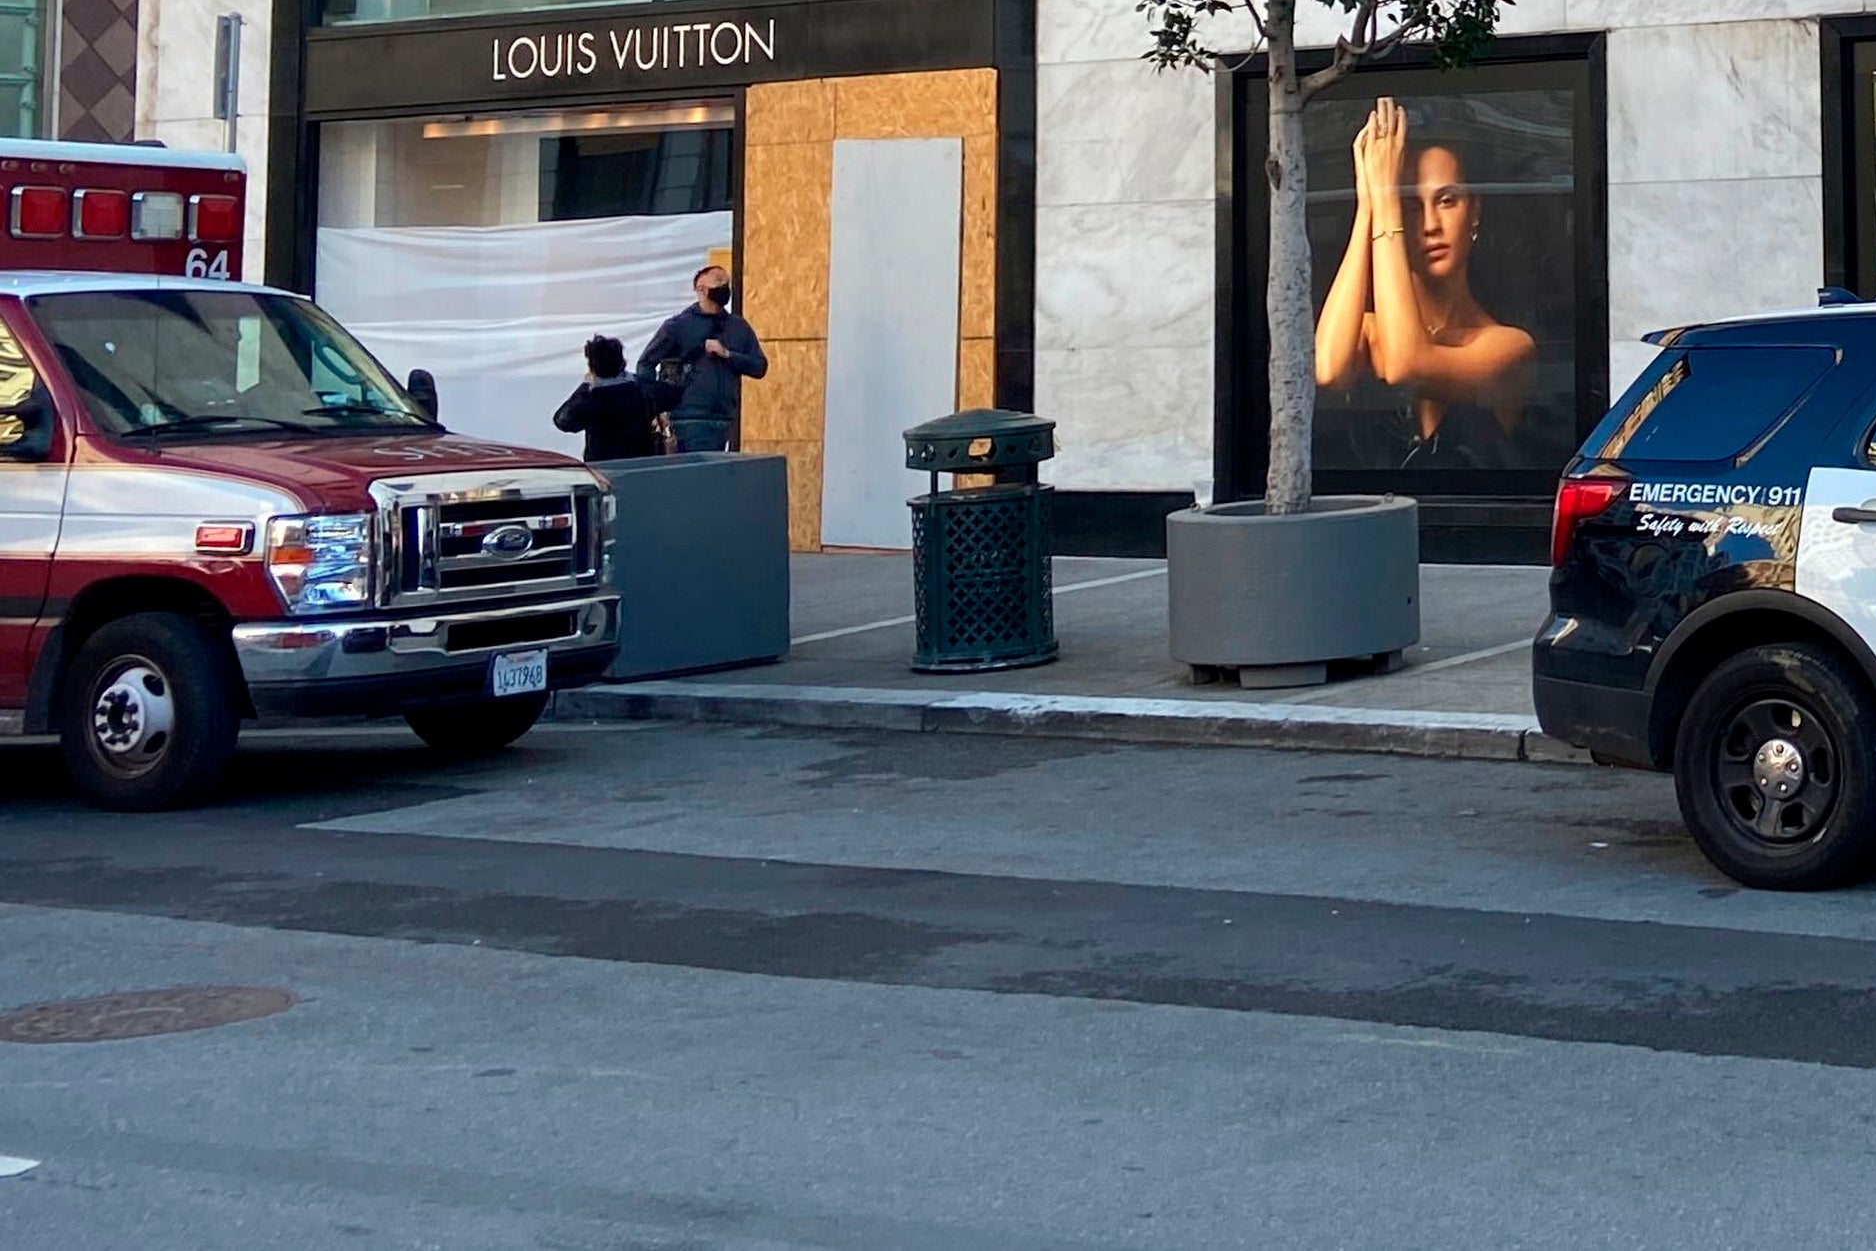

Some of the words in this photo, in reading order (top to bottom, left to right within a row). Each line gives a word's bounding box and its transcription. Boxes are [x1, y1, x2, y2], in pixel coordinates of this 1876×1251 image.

[492, 32, 597, 80] LOUIS
[609, 18, 776, 71] VUITTON
[185, 248, 231, 280] 64
[1629, 482, 1761, 505] EMERGENCY
[1768, 485, 1801, 506] 911
[1636, 513, 1685, 537] Safety
[1688, 516, 1721, 534] with
[1724, 515, 1782, 538] Respect
